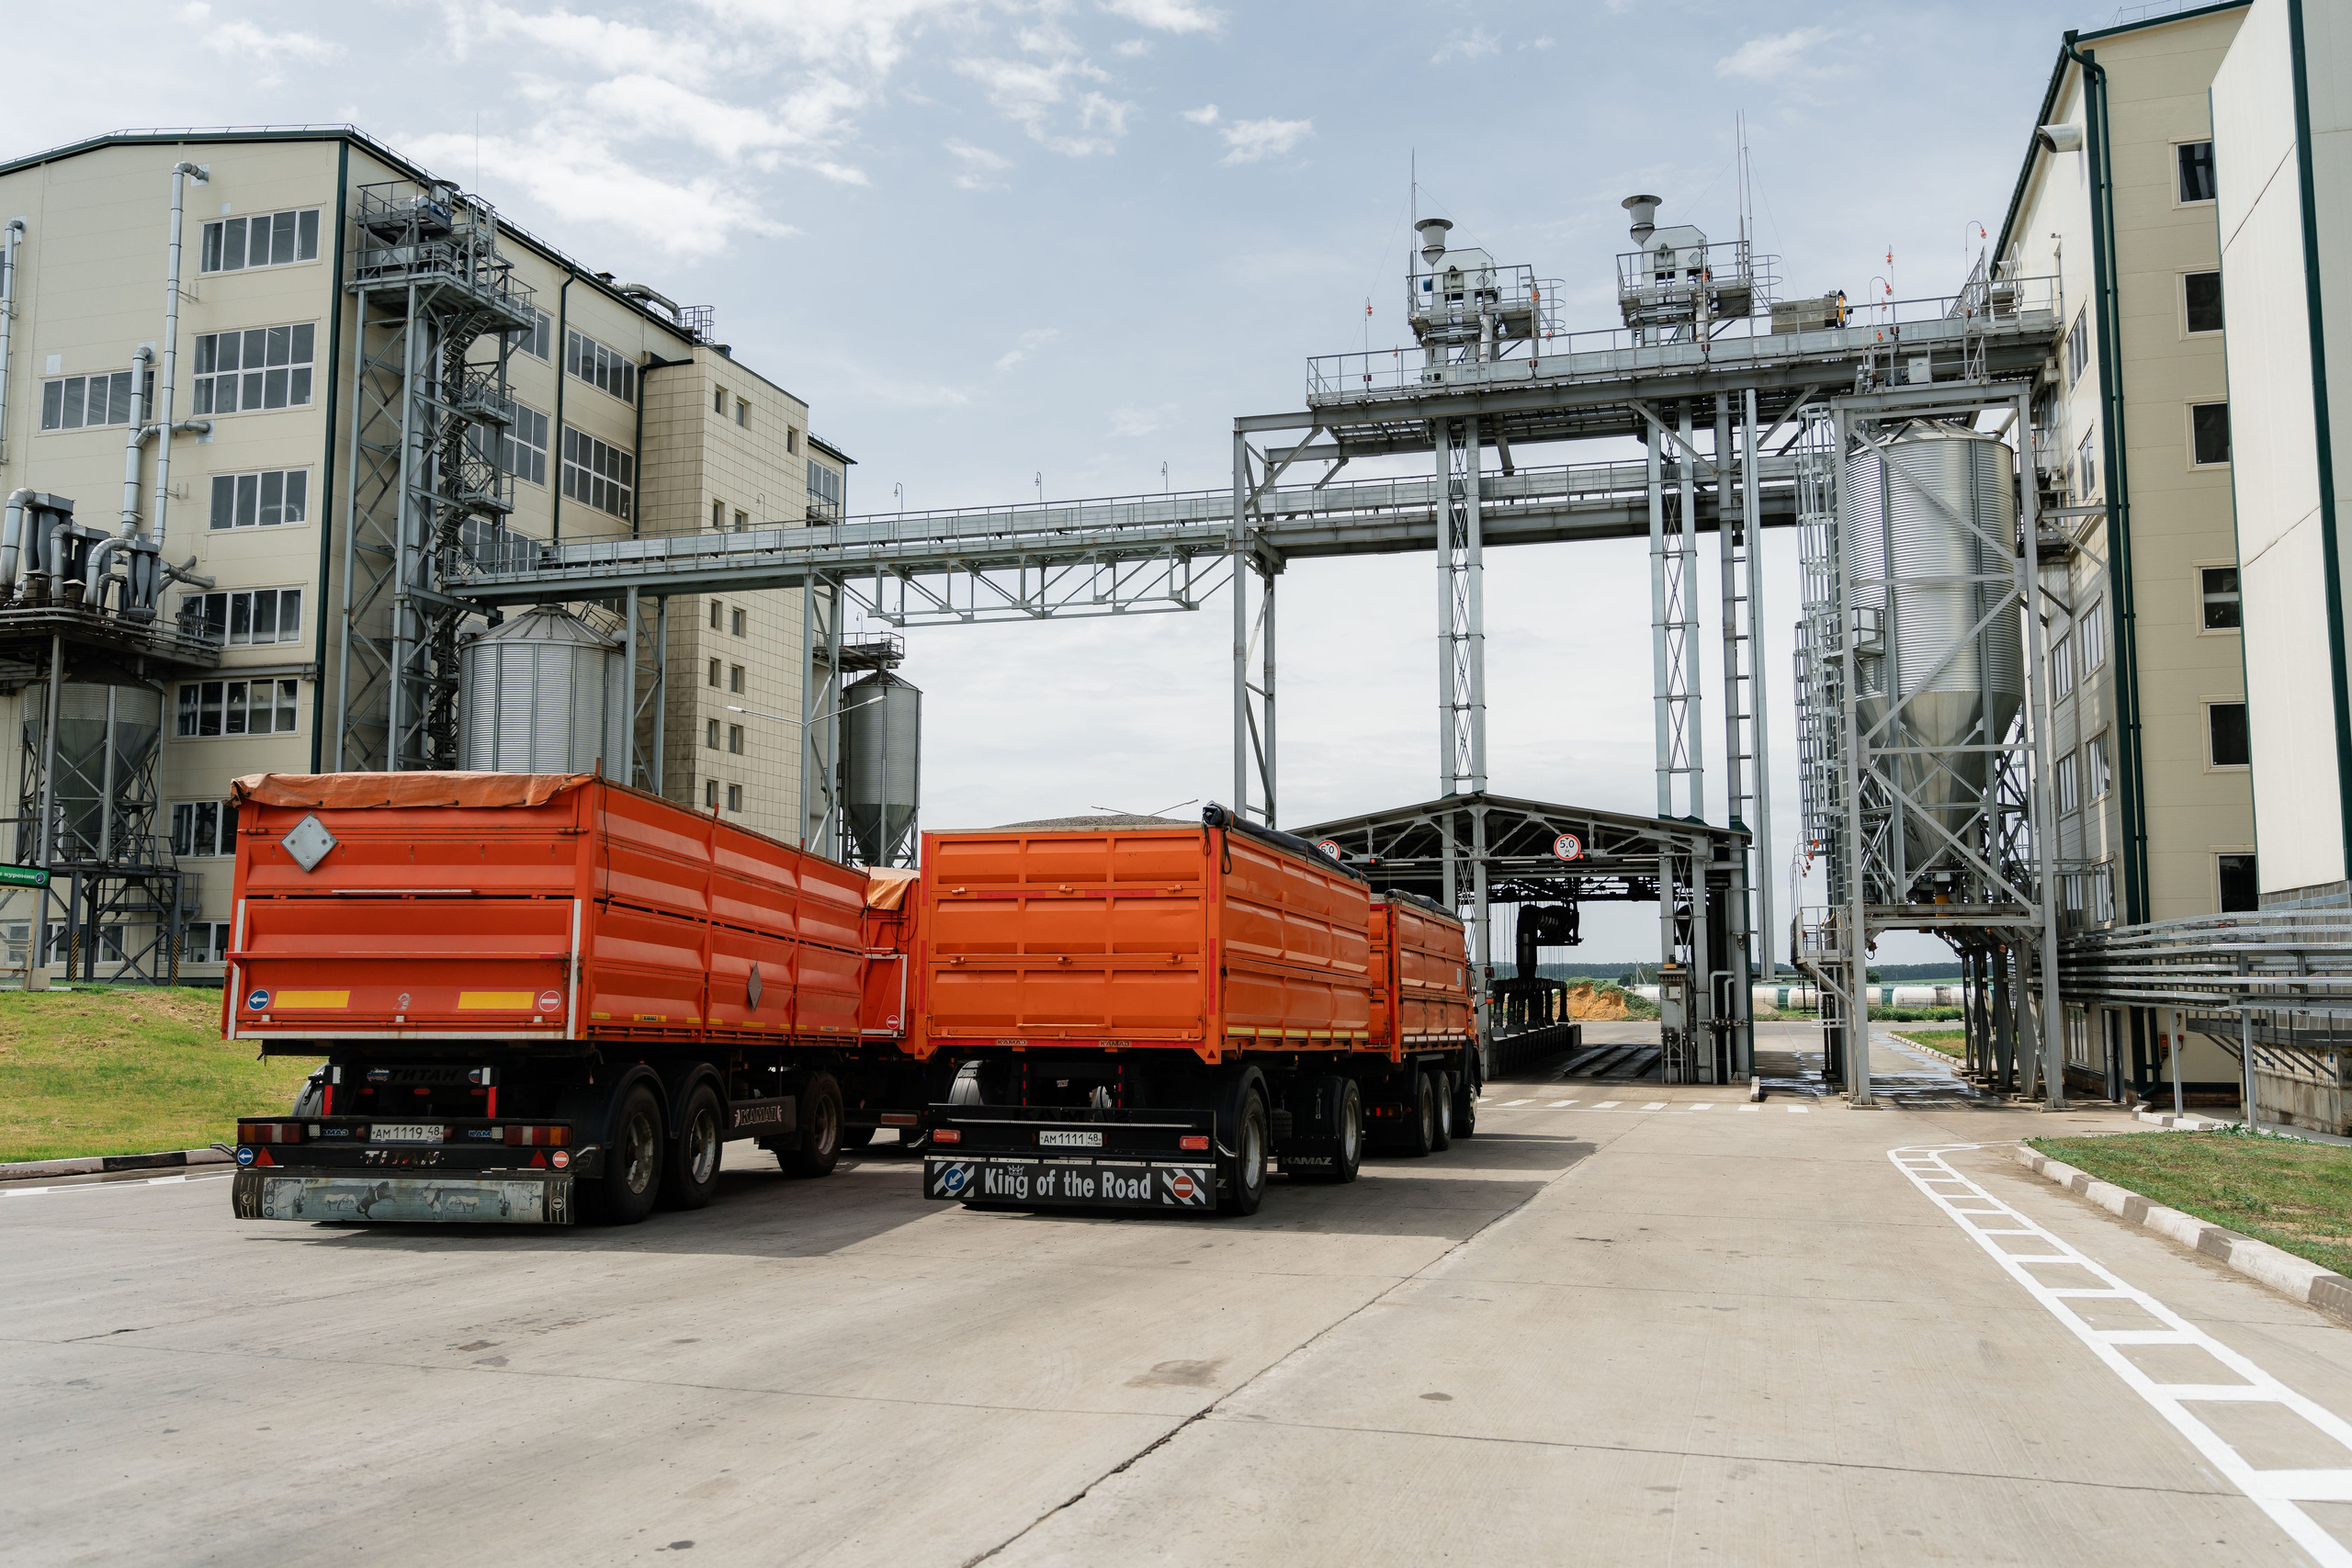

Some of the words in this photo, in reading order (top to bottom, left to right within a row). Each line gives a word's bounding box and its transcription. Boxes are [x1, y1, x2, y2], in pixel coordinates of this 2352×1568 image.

[4, 872, 35, 880] курения
[390, 1069, 458, 1081] ТИТАН
[741, 1106, 776, 1125] KAMAZ
[322, 1128, 349, 1137] АМАЗ
[427, 1126, 440, 1136] 48
[469, 1130, 492, 1138] КАМ
[1088, 1133, 1099, 1142] 48
[1282, 1156, 1332, 1165] KAMAZ
[985, 1168, 1028, 1200] King
[1036, 1168, 1057, 1196] of
[1063, 1170, 1095, 1198] the
[1102, 1171, 1151, 1200] Road
